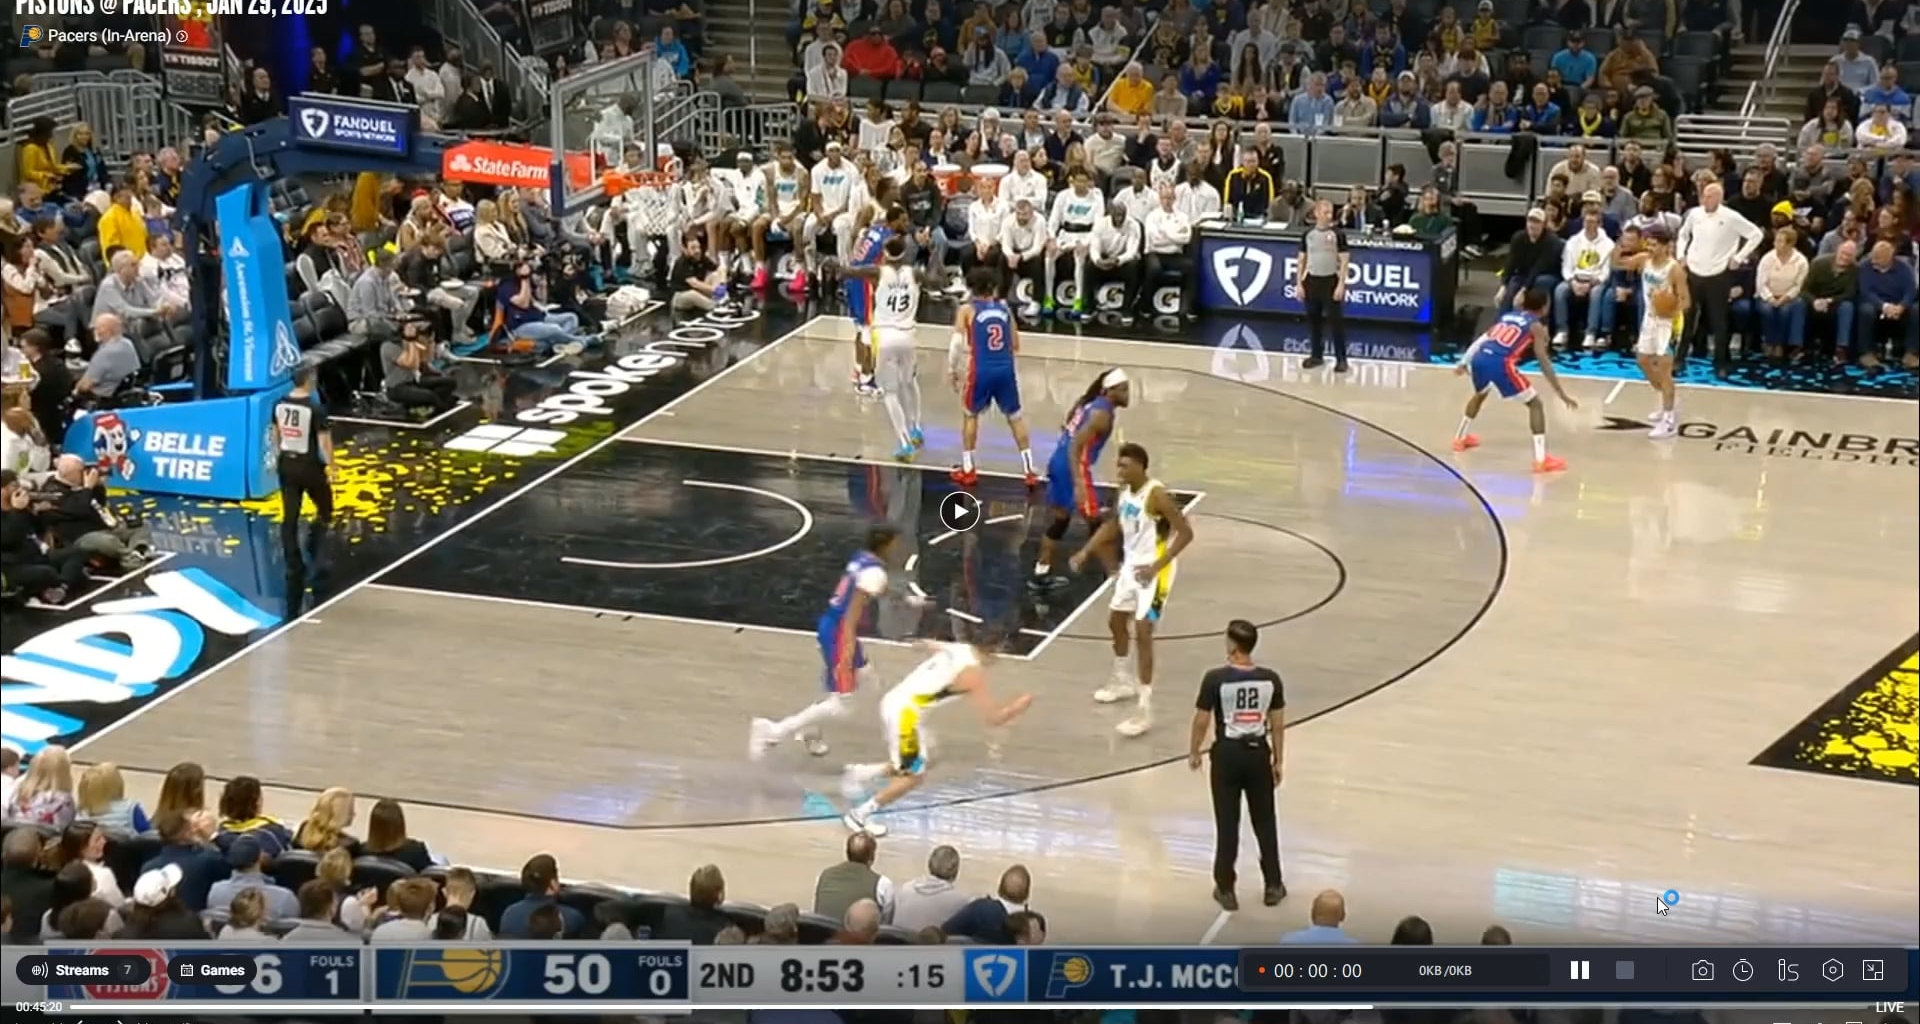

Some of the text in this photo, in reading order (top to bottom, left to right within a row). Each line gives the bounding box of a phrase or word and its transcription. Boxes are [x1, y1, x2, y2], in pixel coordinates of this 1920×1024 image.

[333, 114, 396, 133] FANDUEL
[1284, 257, 1420, 289] FDUEL
[887, 294, 911, 312] 43
[1345, 289, 1419, 307] NETWORK
[986, 324, 1004, 351] 2
[283, 408, 299, 427] 78
[144, 430, 226, 458] BELLE
[1677, 422, 1919, 456] GAINBR
[152, 456, 214, 481] TIRE
[1236, 687, 1258, 709] 82
[310, 955, 355, 967] FOULS
[638, 955, 683, 967] FOULS
[325, 970, 339, 995] 1
[543, 954, 611, 994] 50
[649, 969, 672, 996] 0
[700, 958, 945, 993] 2ND 8:53 :15
[1109, 963, 1238, 989] T.J. MCC
